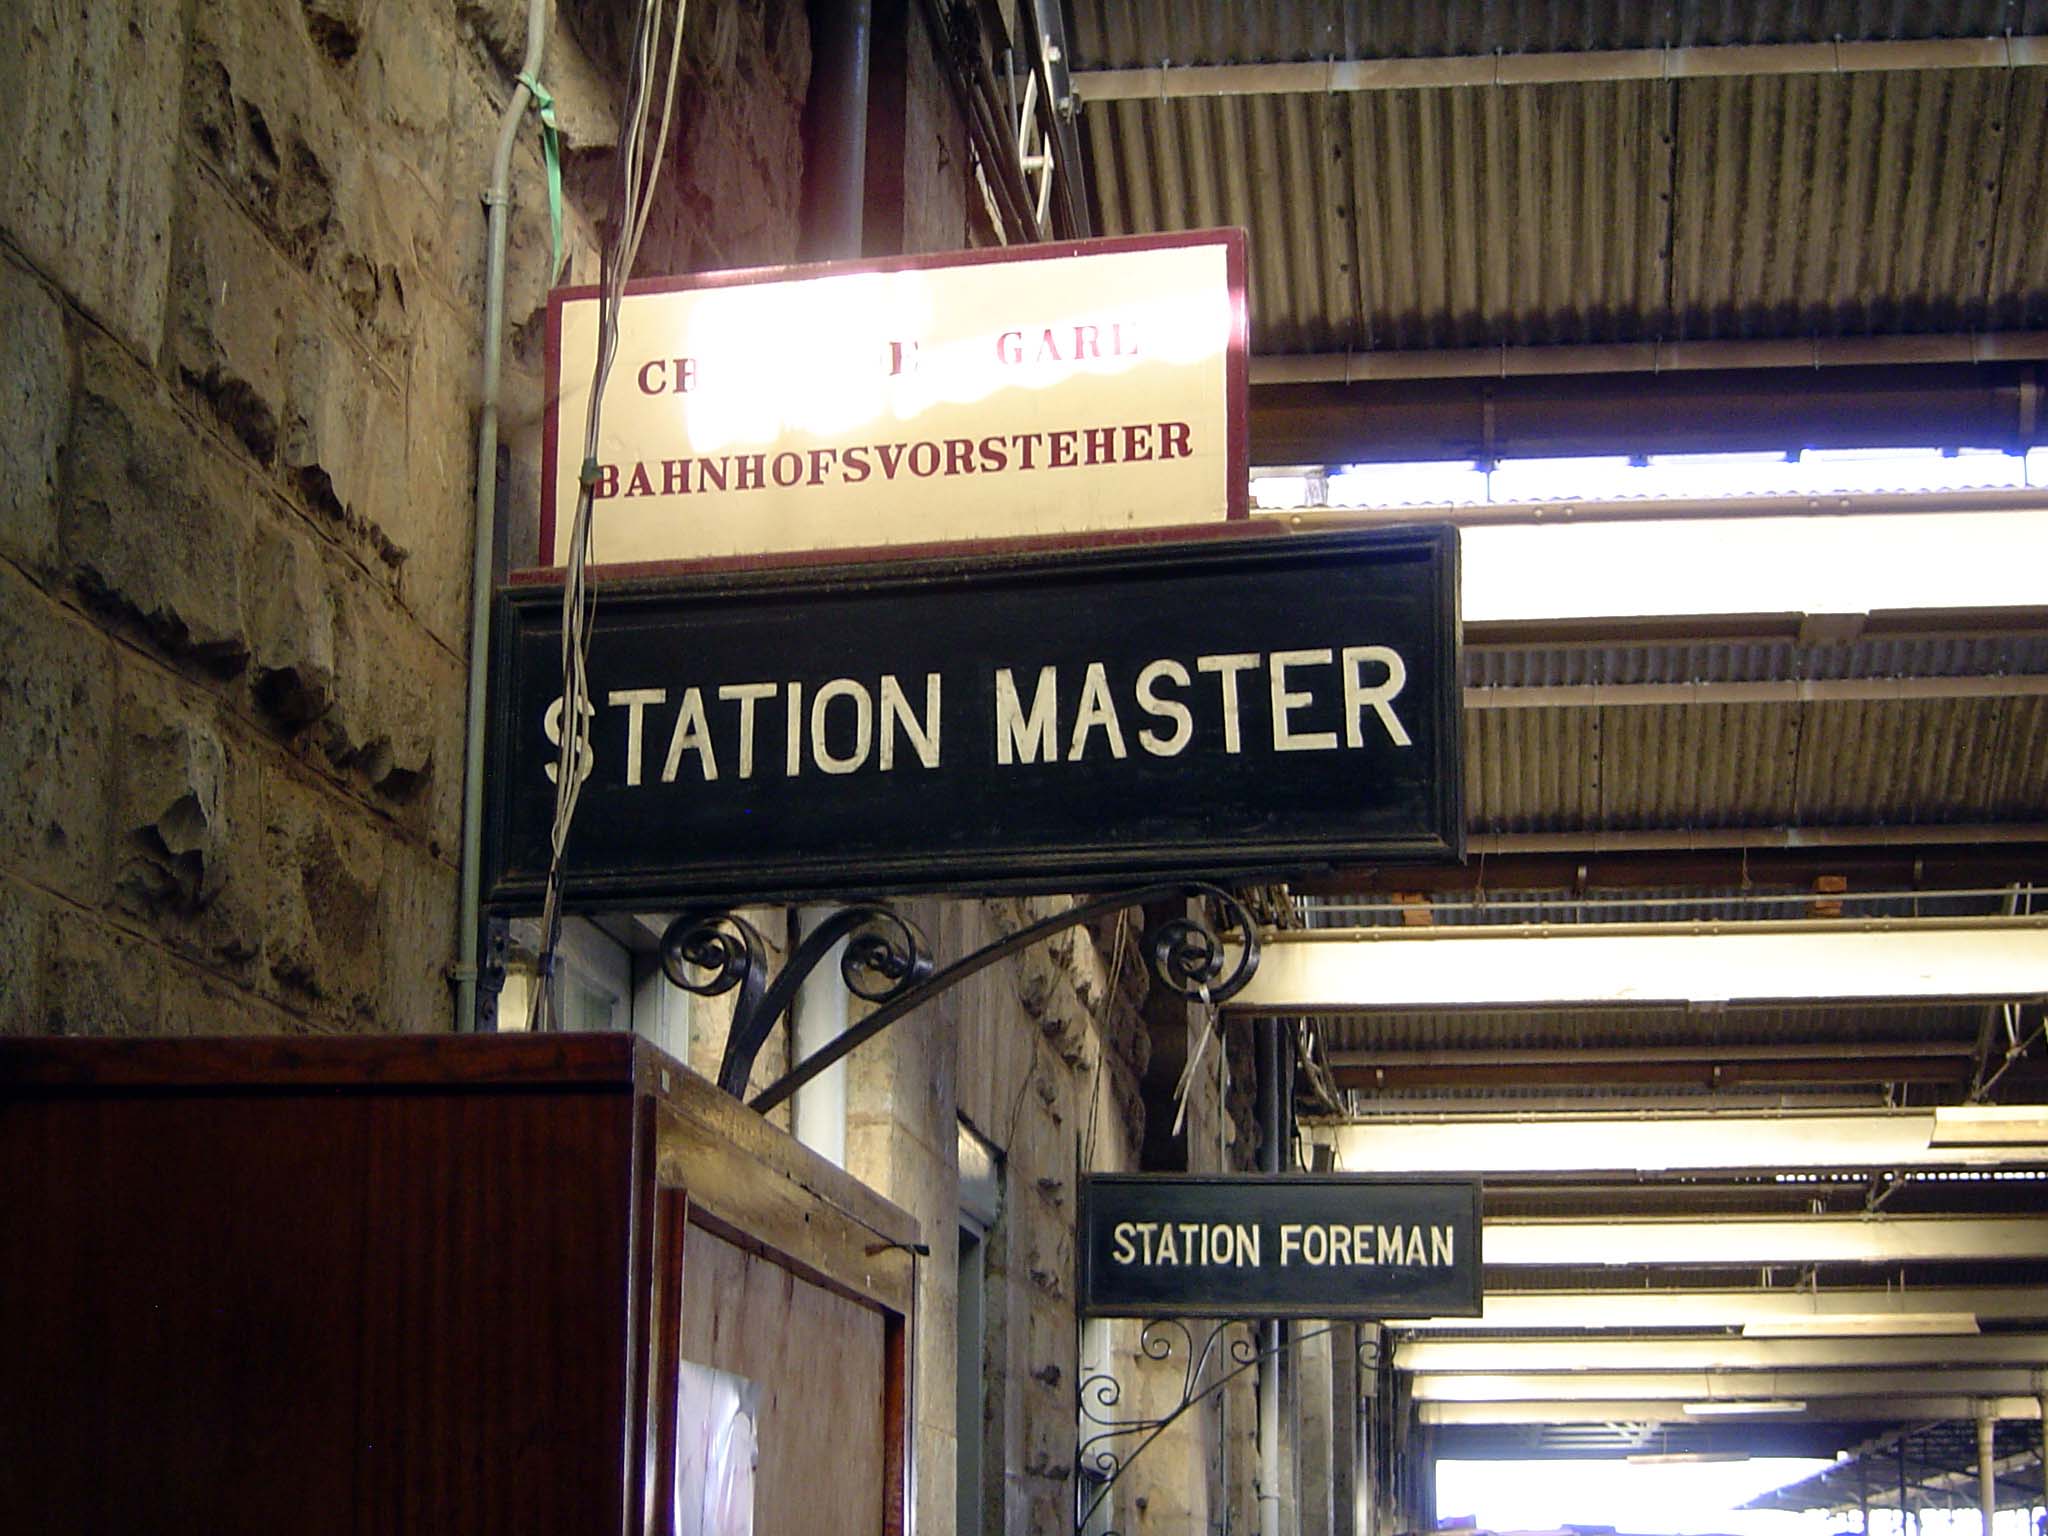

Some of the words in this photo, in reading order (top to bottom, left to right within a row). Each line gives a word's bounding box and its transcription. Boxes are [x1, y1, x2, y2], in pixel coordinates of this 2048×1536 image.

[594, 421, 1194, 500] BAHNHOFSVORSTEHER
[543, 671, 942, 787] STATION
[996, 645, 1413, 766] MASTER
[1112, 1221, 1260, 1267] STATION
[1280, 1224, 1454, 1267] FOREMAN
